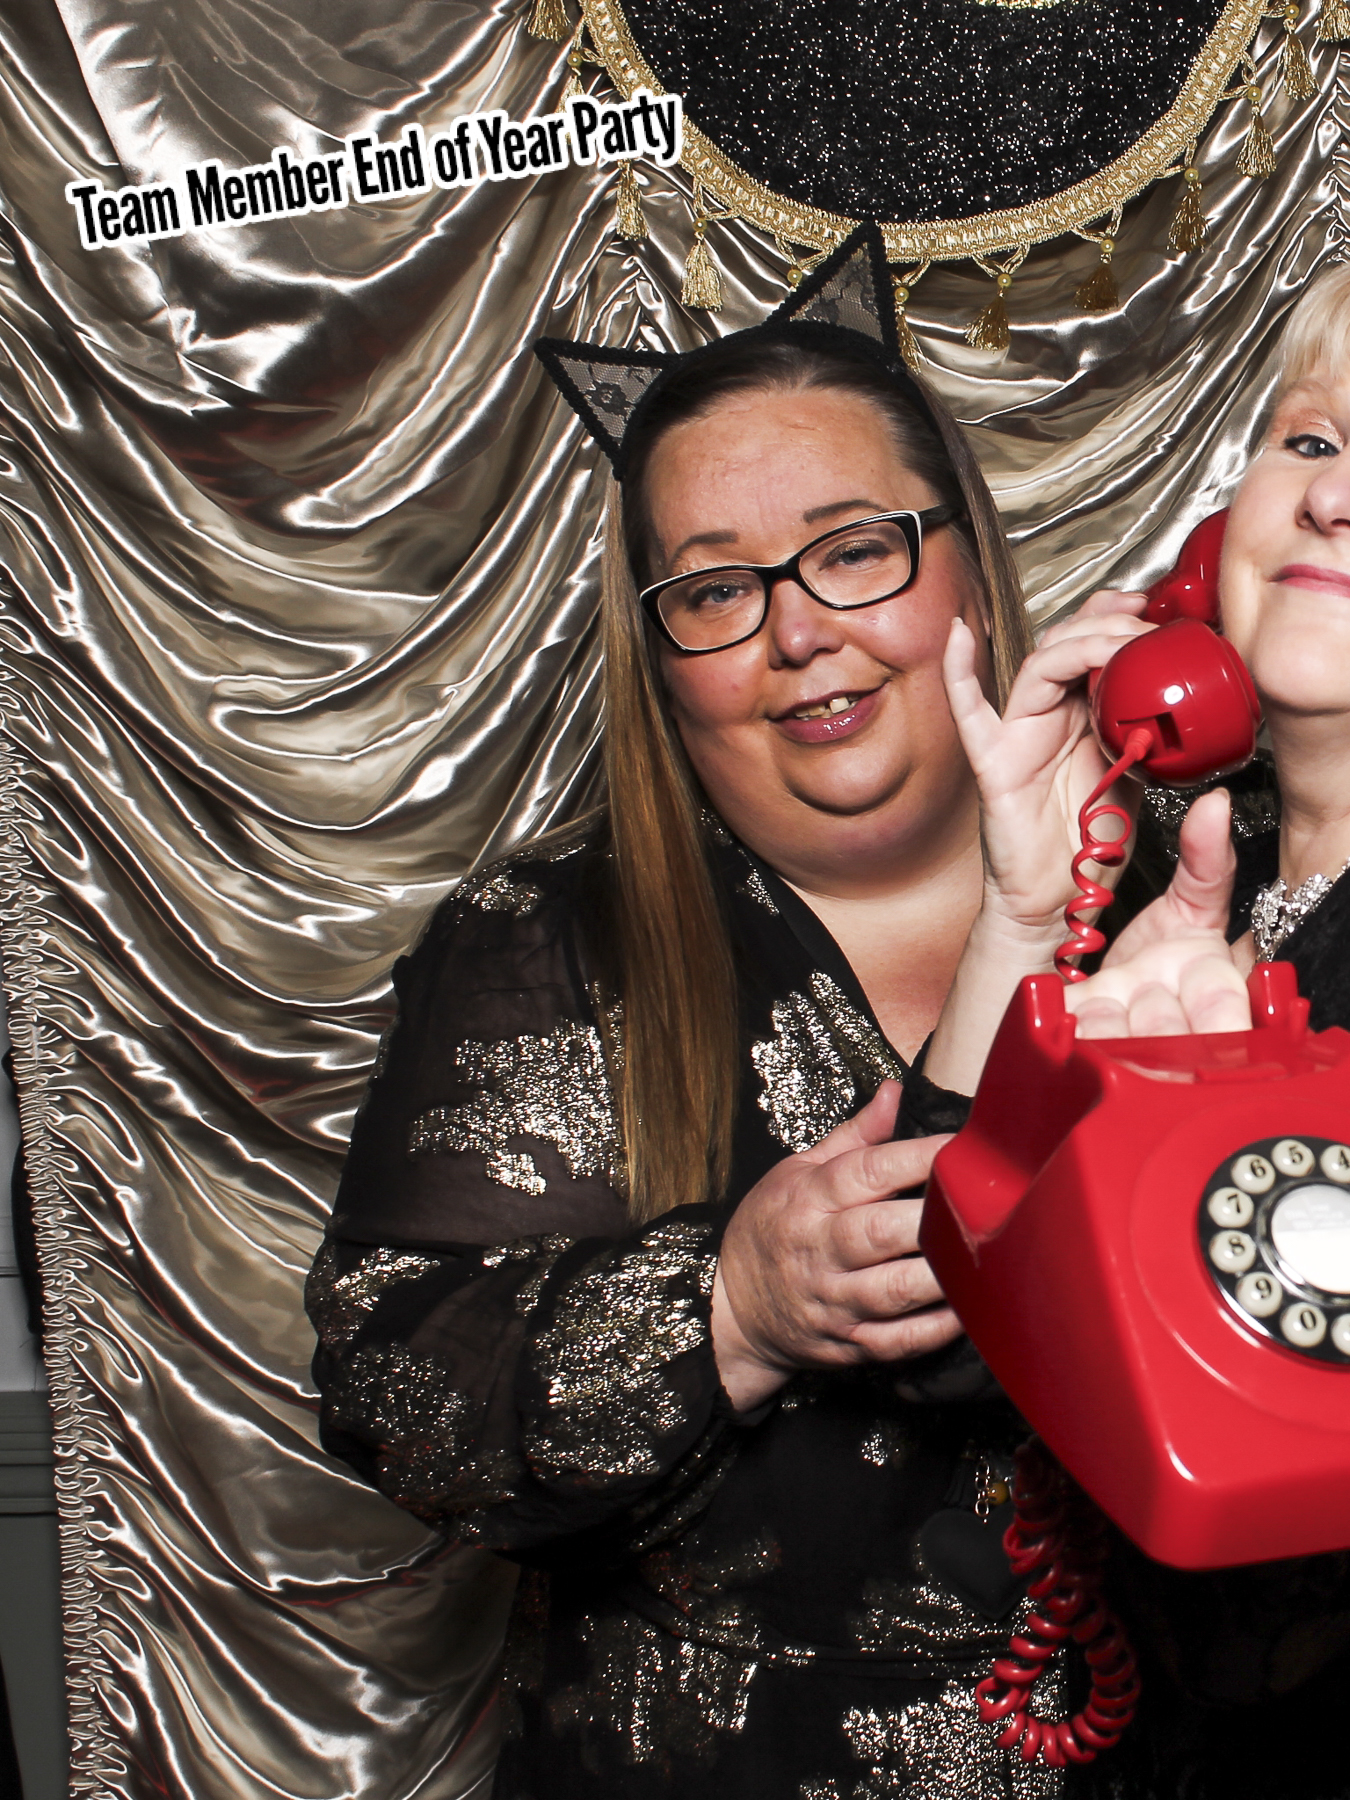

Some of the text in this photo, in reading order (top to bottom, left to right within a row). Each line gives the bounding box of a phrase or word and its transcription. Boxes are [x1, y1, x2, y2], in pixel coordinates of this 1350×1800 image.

[1288, 1145, 1304, 1164] 5
[1250, 1159, 1267, 1179] 6
[1227, 1193, 1242, 1214] 7
[1228, 1236, 1246, 1256] 8
[1255, 1278, 1272, 1299] 9
